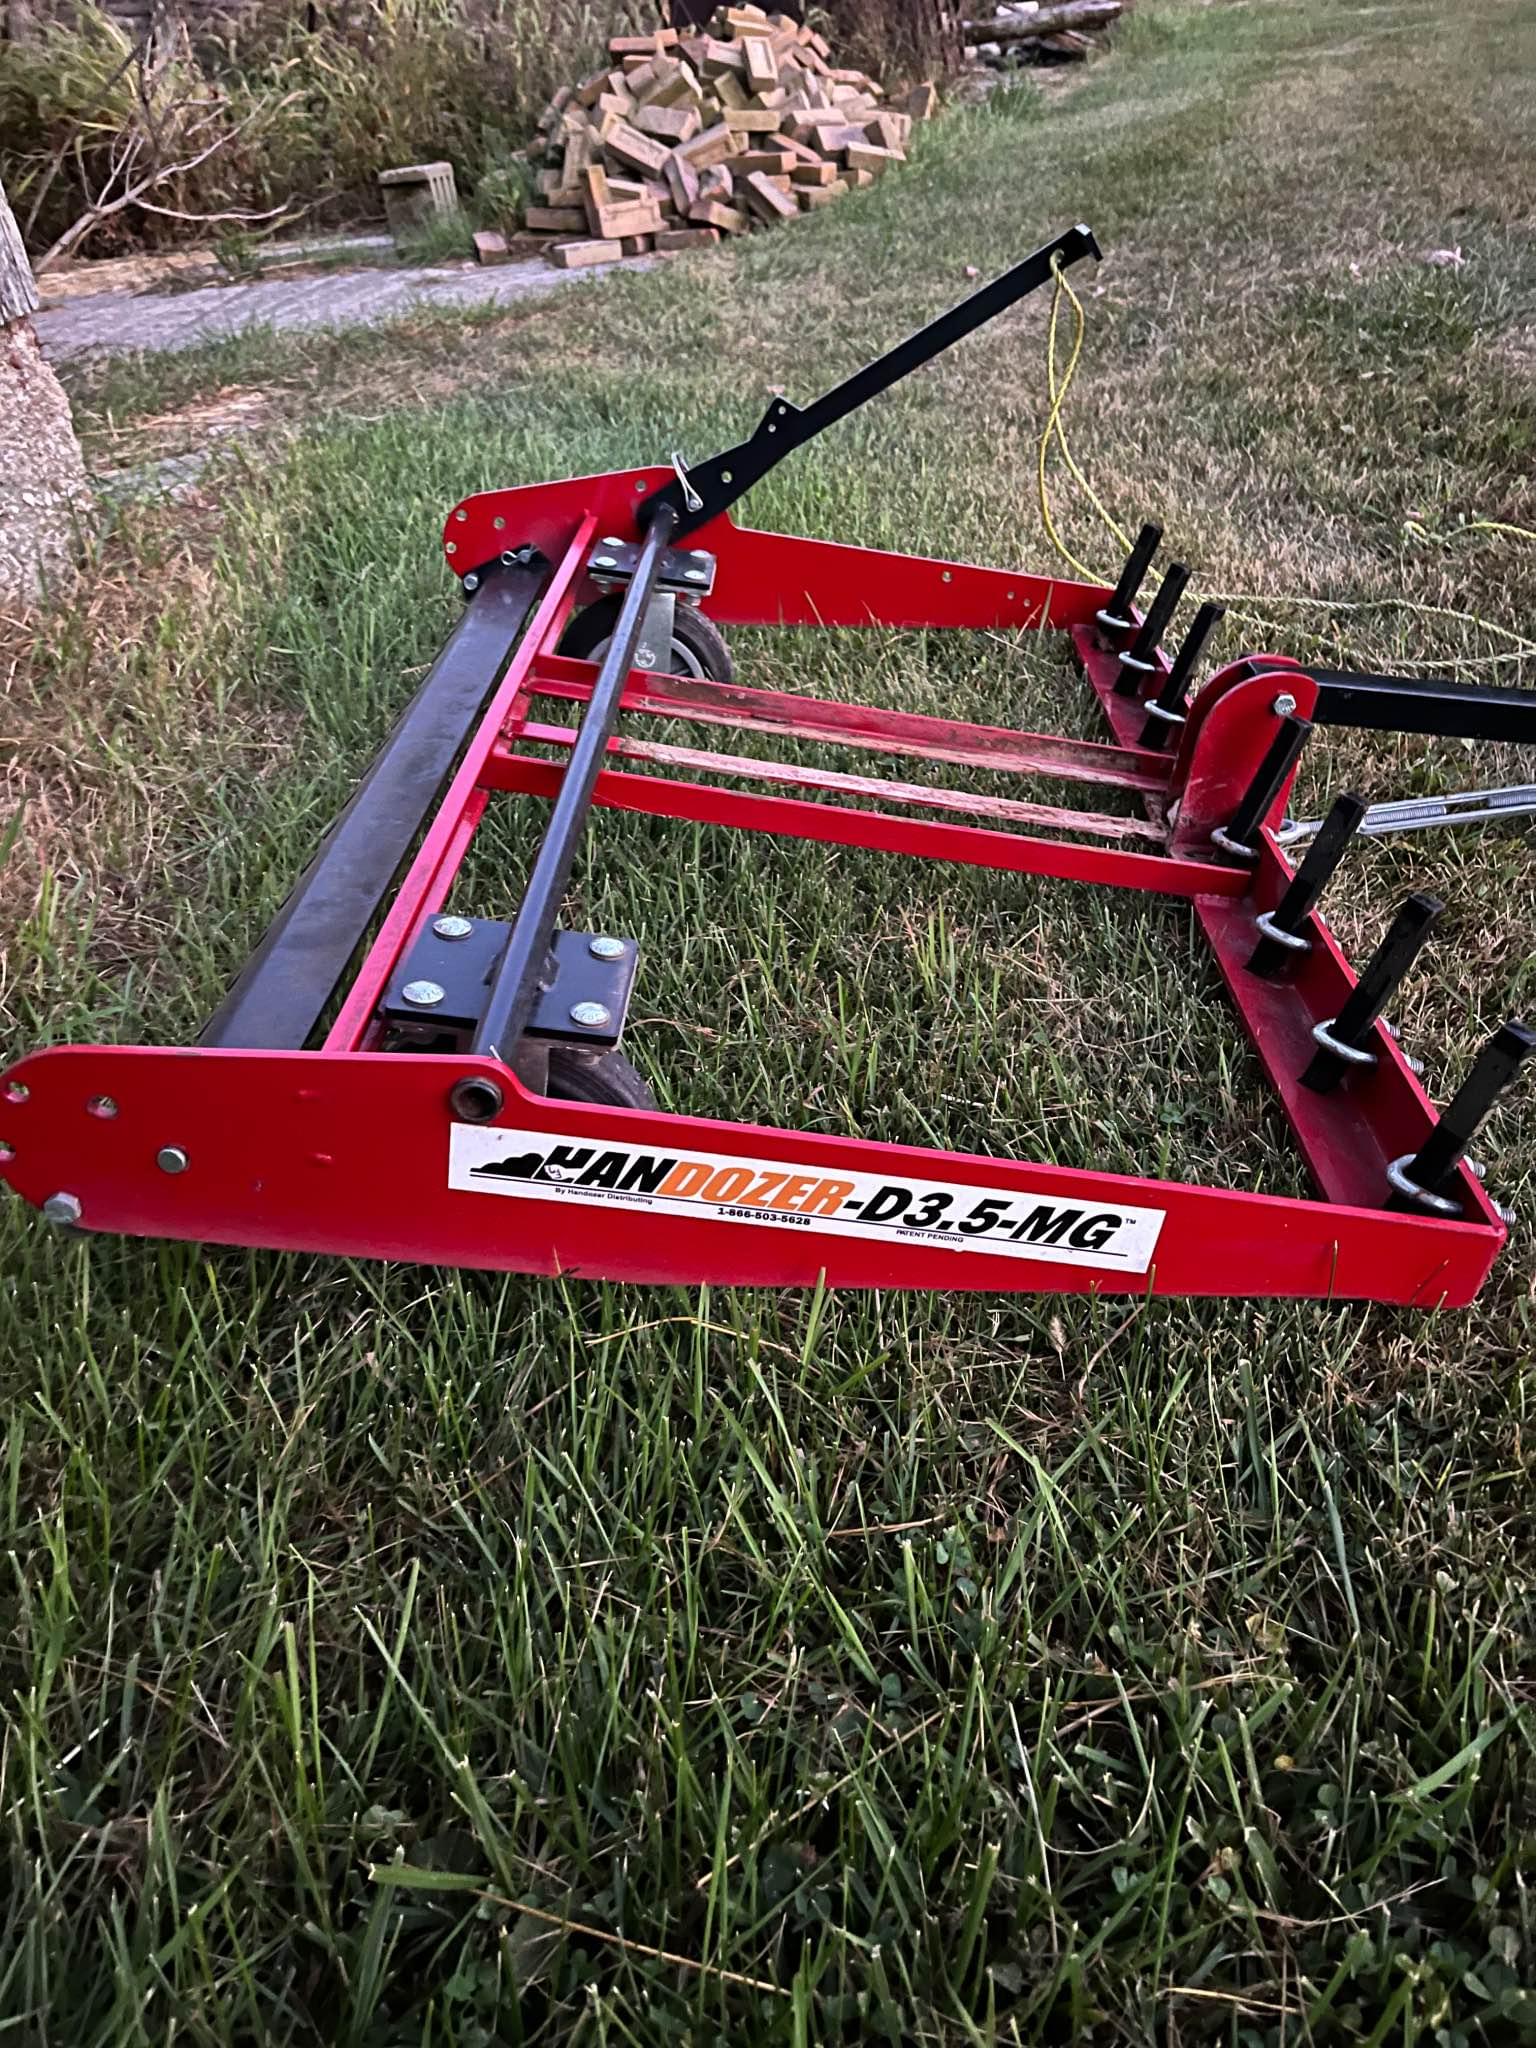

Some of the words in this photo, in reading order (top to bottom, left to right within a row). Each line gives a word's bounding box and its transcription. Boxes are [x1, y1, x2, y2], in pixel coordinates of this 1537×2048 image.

[555, 1187, 565, 1196] By
[607, 1193, 653, 1205] Distributing
[717, 1207, 811, 1226] 1-866-503-5628
[896, 1229, 925, 1239] PATENT
[927, 1232, 964, 1243] PENDING
